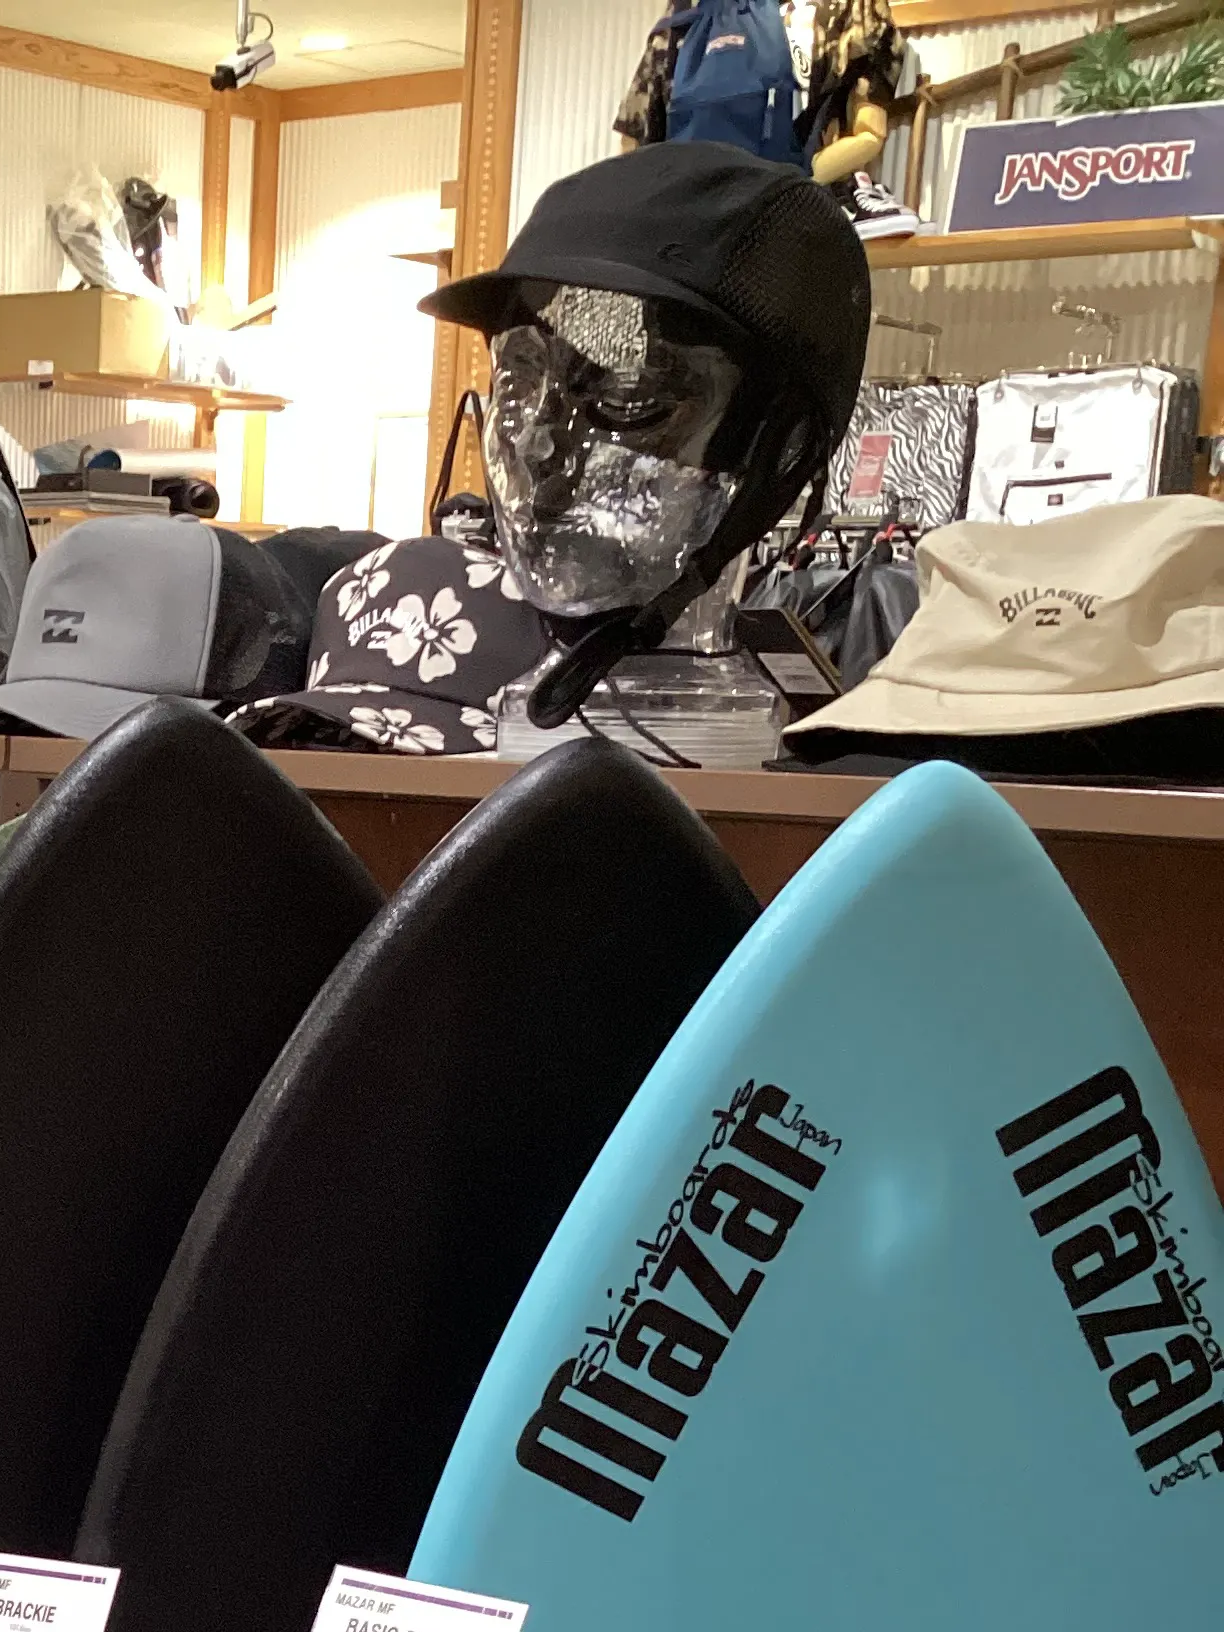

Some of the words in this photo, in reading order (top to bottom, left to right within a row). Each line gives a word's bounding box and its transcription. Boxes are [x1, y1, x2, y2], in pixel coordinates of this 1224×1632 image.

[995, 140, 1196, 205] JANSPORT
[778, 1103, 842, 1156] Japan
[335, 1592, 375, 1611] MAZAR
[377, 1601, 396, 1615] MF
